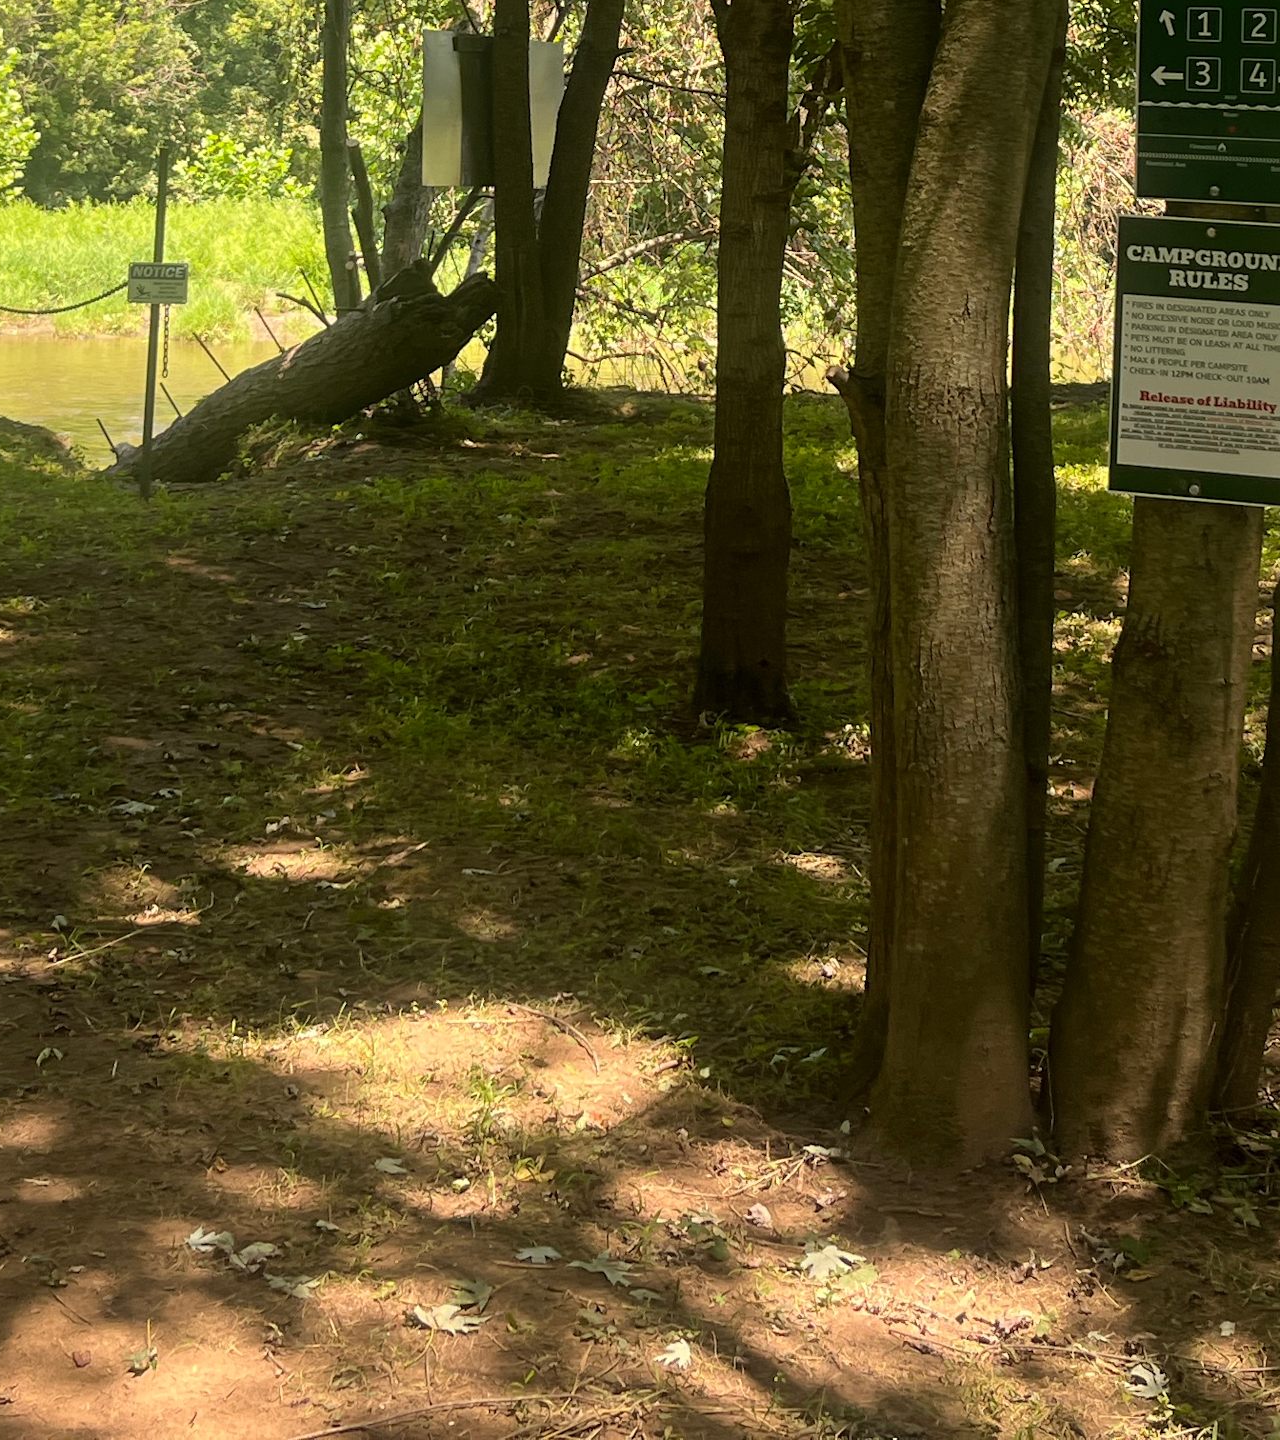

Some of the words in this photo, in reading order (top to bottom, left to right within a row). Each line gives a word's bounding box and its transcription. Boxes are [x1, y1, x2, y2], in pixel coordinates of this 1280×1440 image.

[1197, 12, 1212, 36] 1
[1251, 12, 1267, 38] 2
[1195, 62, 1210, 87] 3
[1248, 63, 1267, 88] 4
[132, 266, 185, 278] NOTICE
[1169, 269, 1250, 292] RULES
[1132, 301, 1153, 309] FIRES
[1167, 304, 1216, 313] DESIGNATED
[1219, 307, 1245, 316] AREAS
[1248, 310, 1271, 318] ONLY
[1132, 312, 1144, 320] NO
[1146, 313, 1188, 323] EXCESSIVE
[1191, 316, 1214, 325] NOISE
[1232, 320, 1254, 328] LOUD
[1131, 324, 1167, 333] PARKING
[1179, 327, 1229, 337] DESIGNATED
[1231, 330, 1253, 339] AREA
[1256, 333, 1278, 341] ONLY
[1131, 334, 1150, 342] PETS
[1152, 336, 1175, 344] MUST
[1205, 339, 1230, 348] LEASH
[1146, 346, 1185, 356] LITTERING
[1130, 356, 1148, 364] MAX
[1158, 358, 1188, 367] PEOPLE
[1191, 360, 1206, 368] PER
[1208, 362, 1248, 372] CAMPSITE
[1130, 366, 1168, 376] CHECK-IN
[1172, 370, 1193, 378] 12PM
[1195, 372, 1243, 383] CHECK-OUT
[1246, 375, 1270, 384] 10AM
[1139, 390, 1194, 405] Release
[1197, 396, 1212, 406] of
[1214, 396, 1278, 414] Liability
